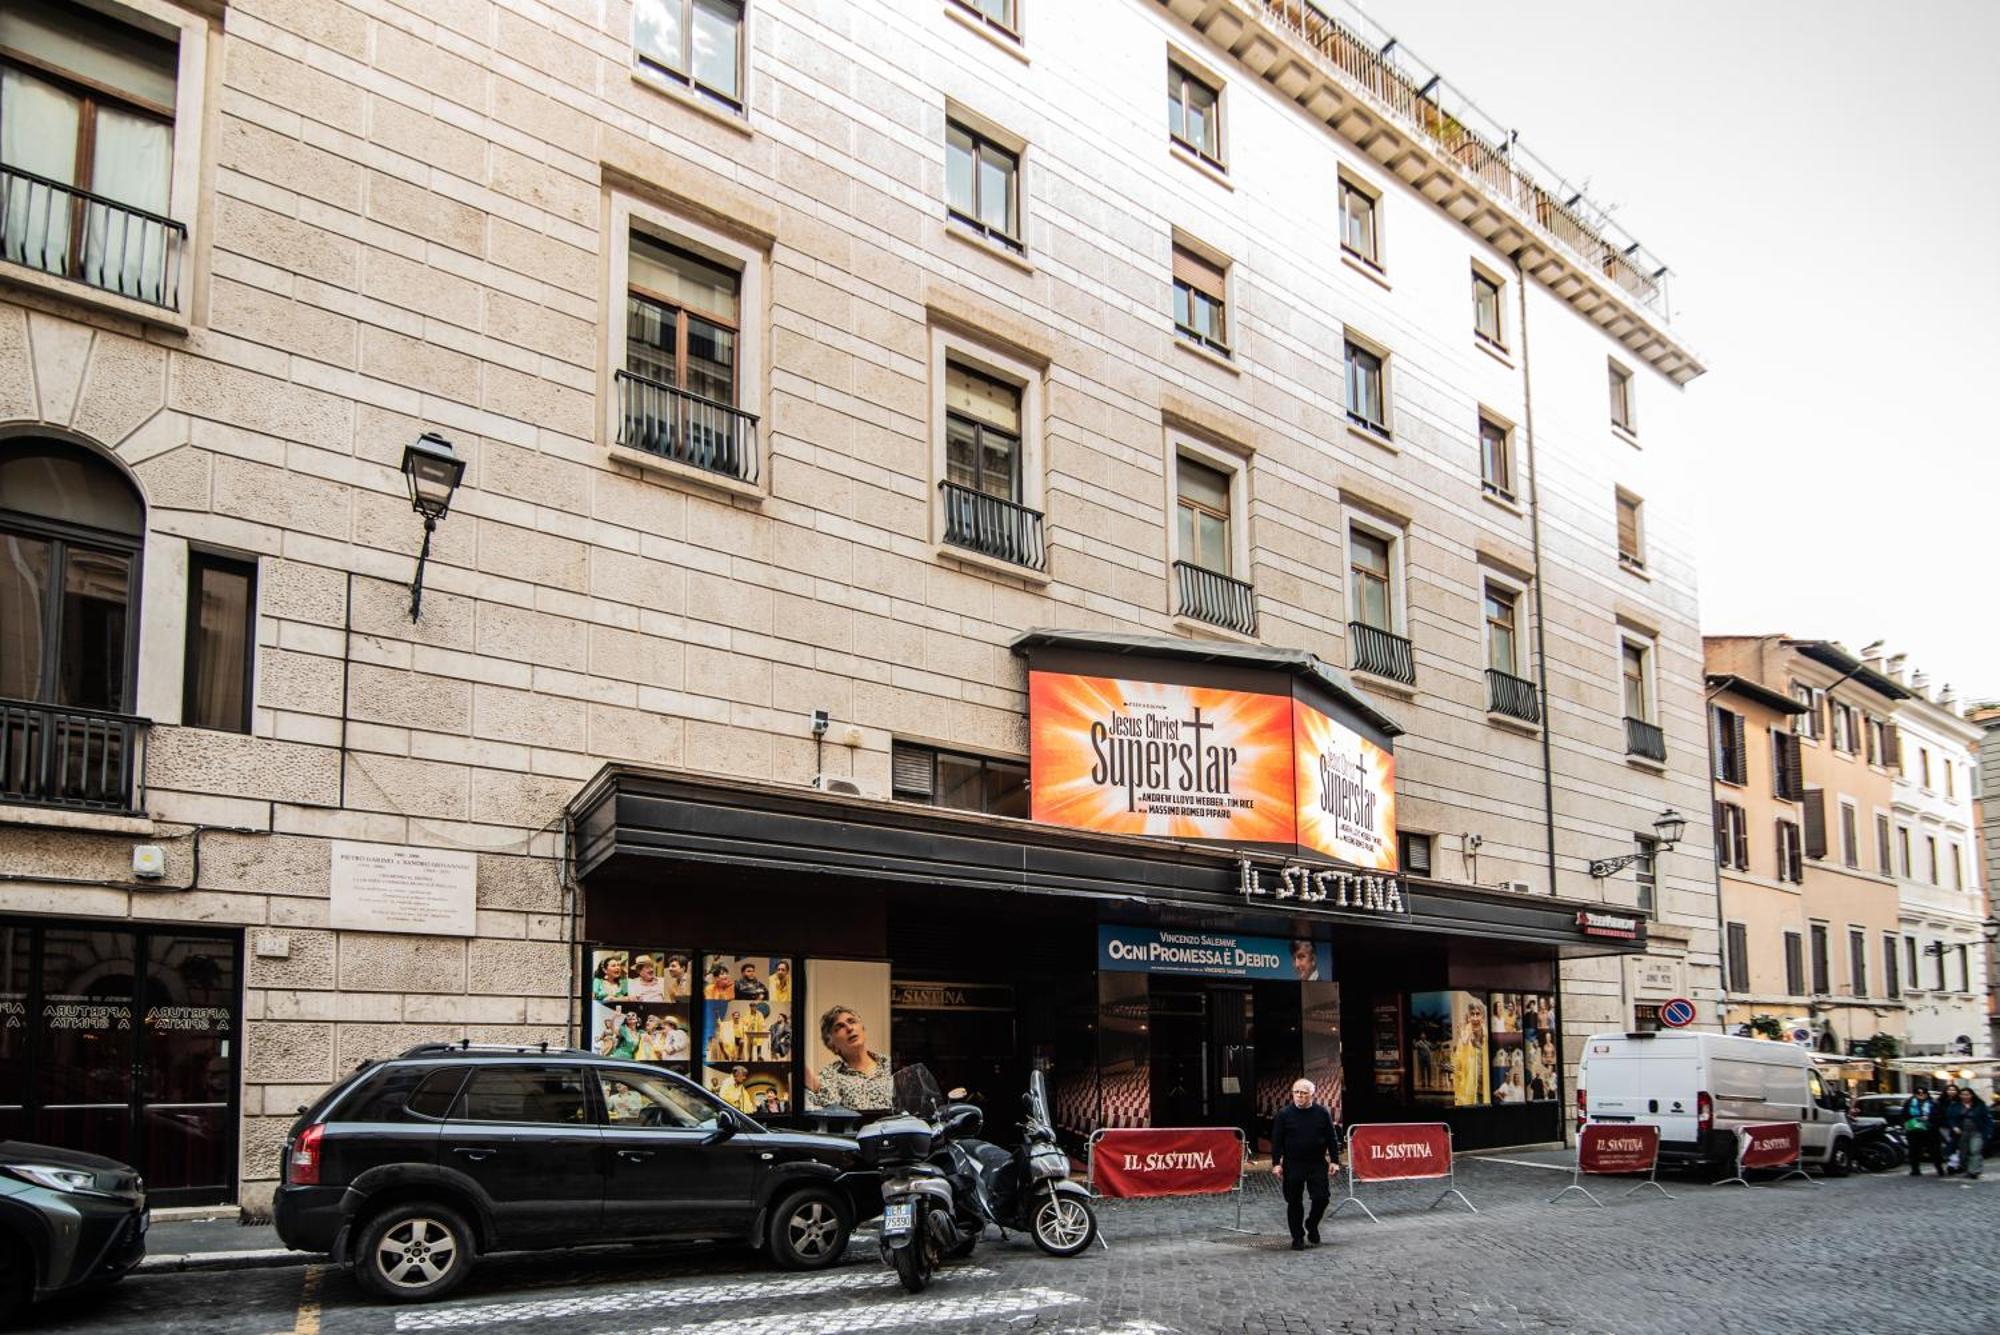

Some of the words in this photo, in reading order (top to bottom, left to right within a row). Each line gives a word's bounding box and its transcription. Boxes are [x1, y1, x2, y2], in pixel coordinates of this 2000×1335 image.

[1109, 710, 1142, 737] Jesus
[1146, 713, 1180, 740] Christ
[1091, 707, 1237, 812] Superstar
[1142, 793, 1172, 804] ANDREW
[1173, 795, 1194, 805] LLOYD
[1196, 796, 1224, 808] WEBBER
[1227, 798, 1239, 808] TIM
[1240, 799, 1254, 809] RICE
[1320, 753, 1376, 839] Superstar
[1149, 805, 1180, 816] MASSIMO
[1181, 807, 1205, 817] ROMEO
[1206, 809, 1231, 819] PIPARO
[1238, 859, 1266, 894] IL
[1276, 865, 1405, 912] SISTINA
[1159, 931, 1200, 945] VINCENZO
[1201, 935, 1236, 948] SALEMME
[1109, 939, 1148, 961] OGNI
[1150, 942, 1221, 965] PROMESSA
[1235, 950, 1280, 969] DEBITO
[902, 990, 966, 1004] SISTINA
[1371, 1145, 1385, 1159] IL
[1386, 1142, 1433, 1160] SISTINA
[1597, 1139, 1605, 1151] IL
[1606, 1137, 1644, 1152] SISTINA
[1762, 1137, 1791, 1151] SISTINA
[1123, 1154, 1142, 1171] IL
[1143, 1149, 1217, 1173] SISTINA
